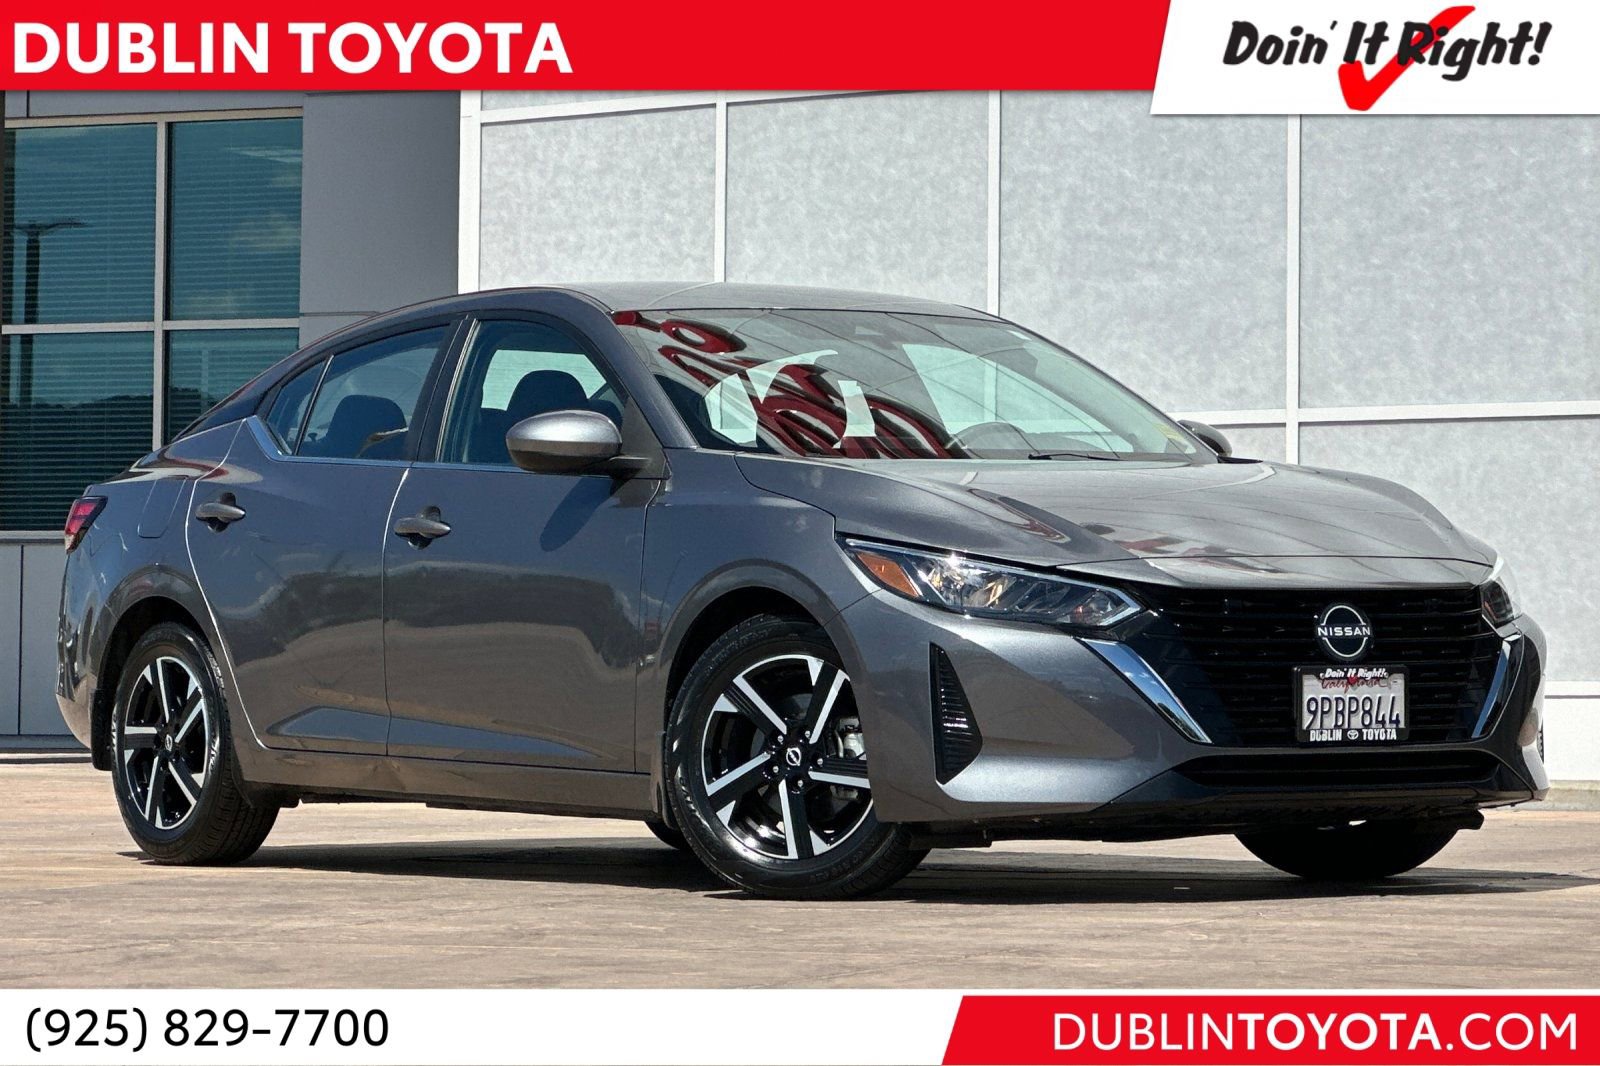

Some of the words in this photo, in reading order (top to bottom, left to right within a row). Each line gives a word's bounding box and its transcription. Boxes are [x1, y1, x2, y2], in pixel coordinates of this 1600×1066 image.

[1317, 626, 1371, 636] NISSAN
[1358, 668, 1385, 680] Right!
[1305, 694, 1401, 730] 9PBP844
[1309, 729, 1343, 742] DUBLIN
[1362, 728, 1397, 741] TOYOTA
